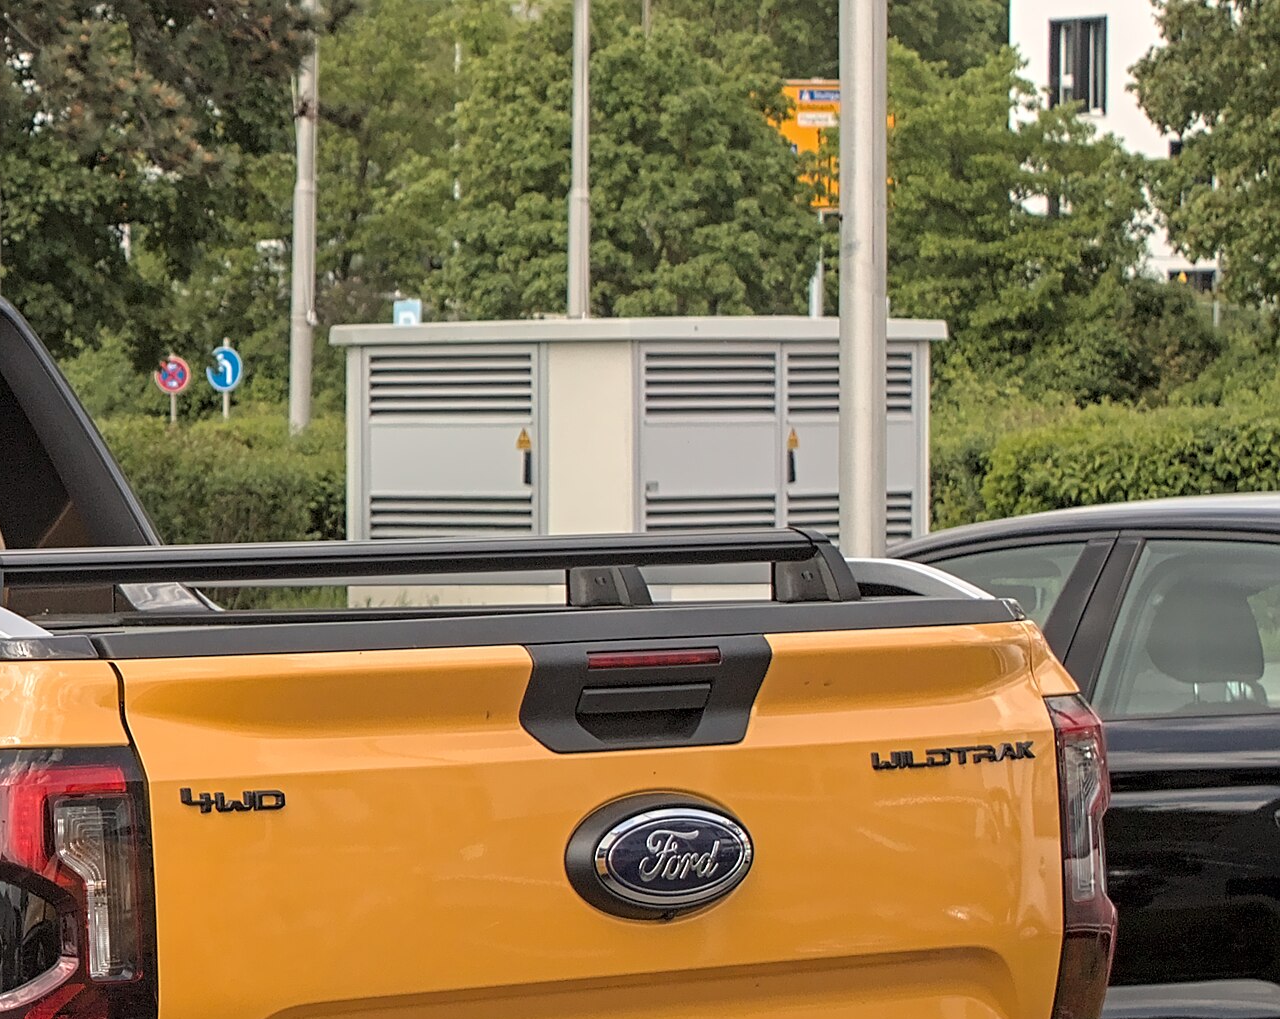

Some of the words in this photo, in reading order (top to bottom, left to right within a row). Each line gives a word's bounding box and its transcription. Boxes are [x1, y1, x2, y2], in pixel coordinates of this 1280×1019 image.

[870, 740, 1036, 771] WILDTRAK
[180, 787, 286, 814] 4WD
[639, 829, 721, 882] Ford
